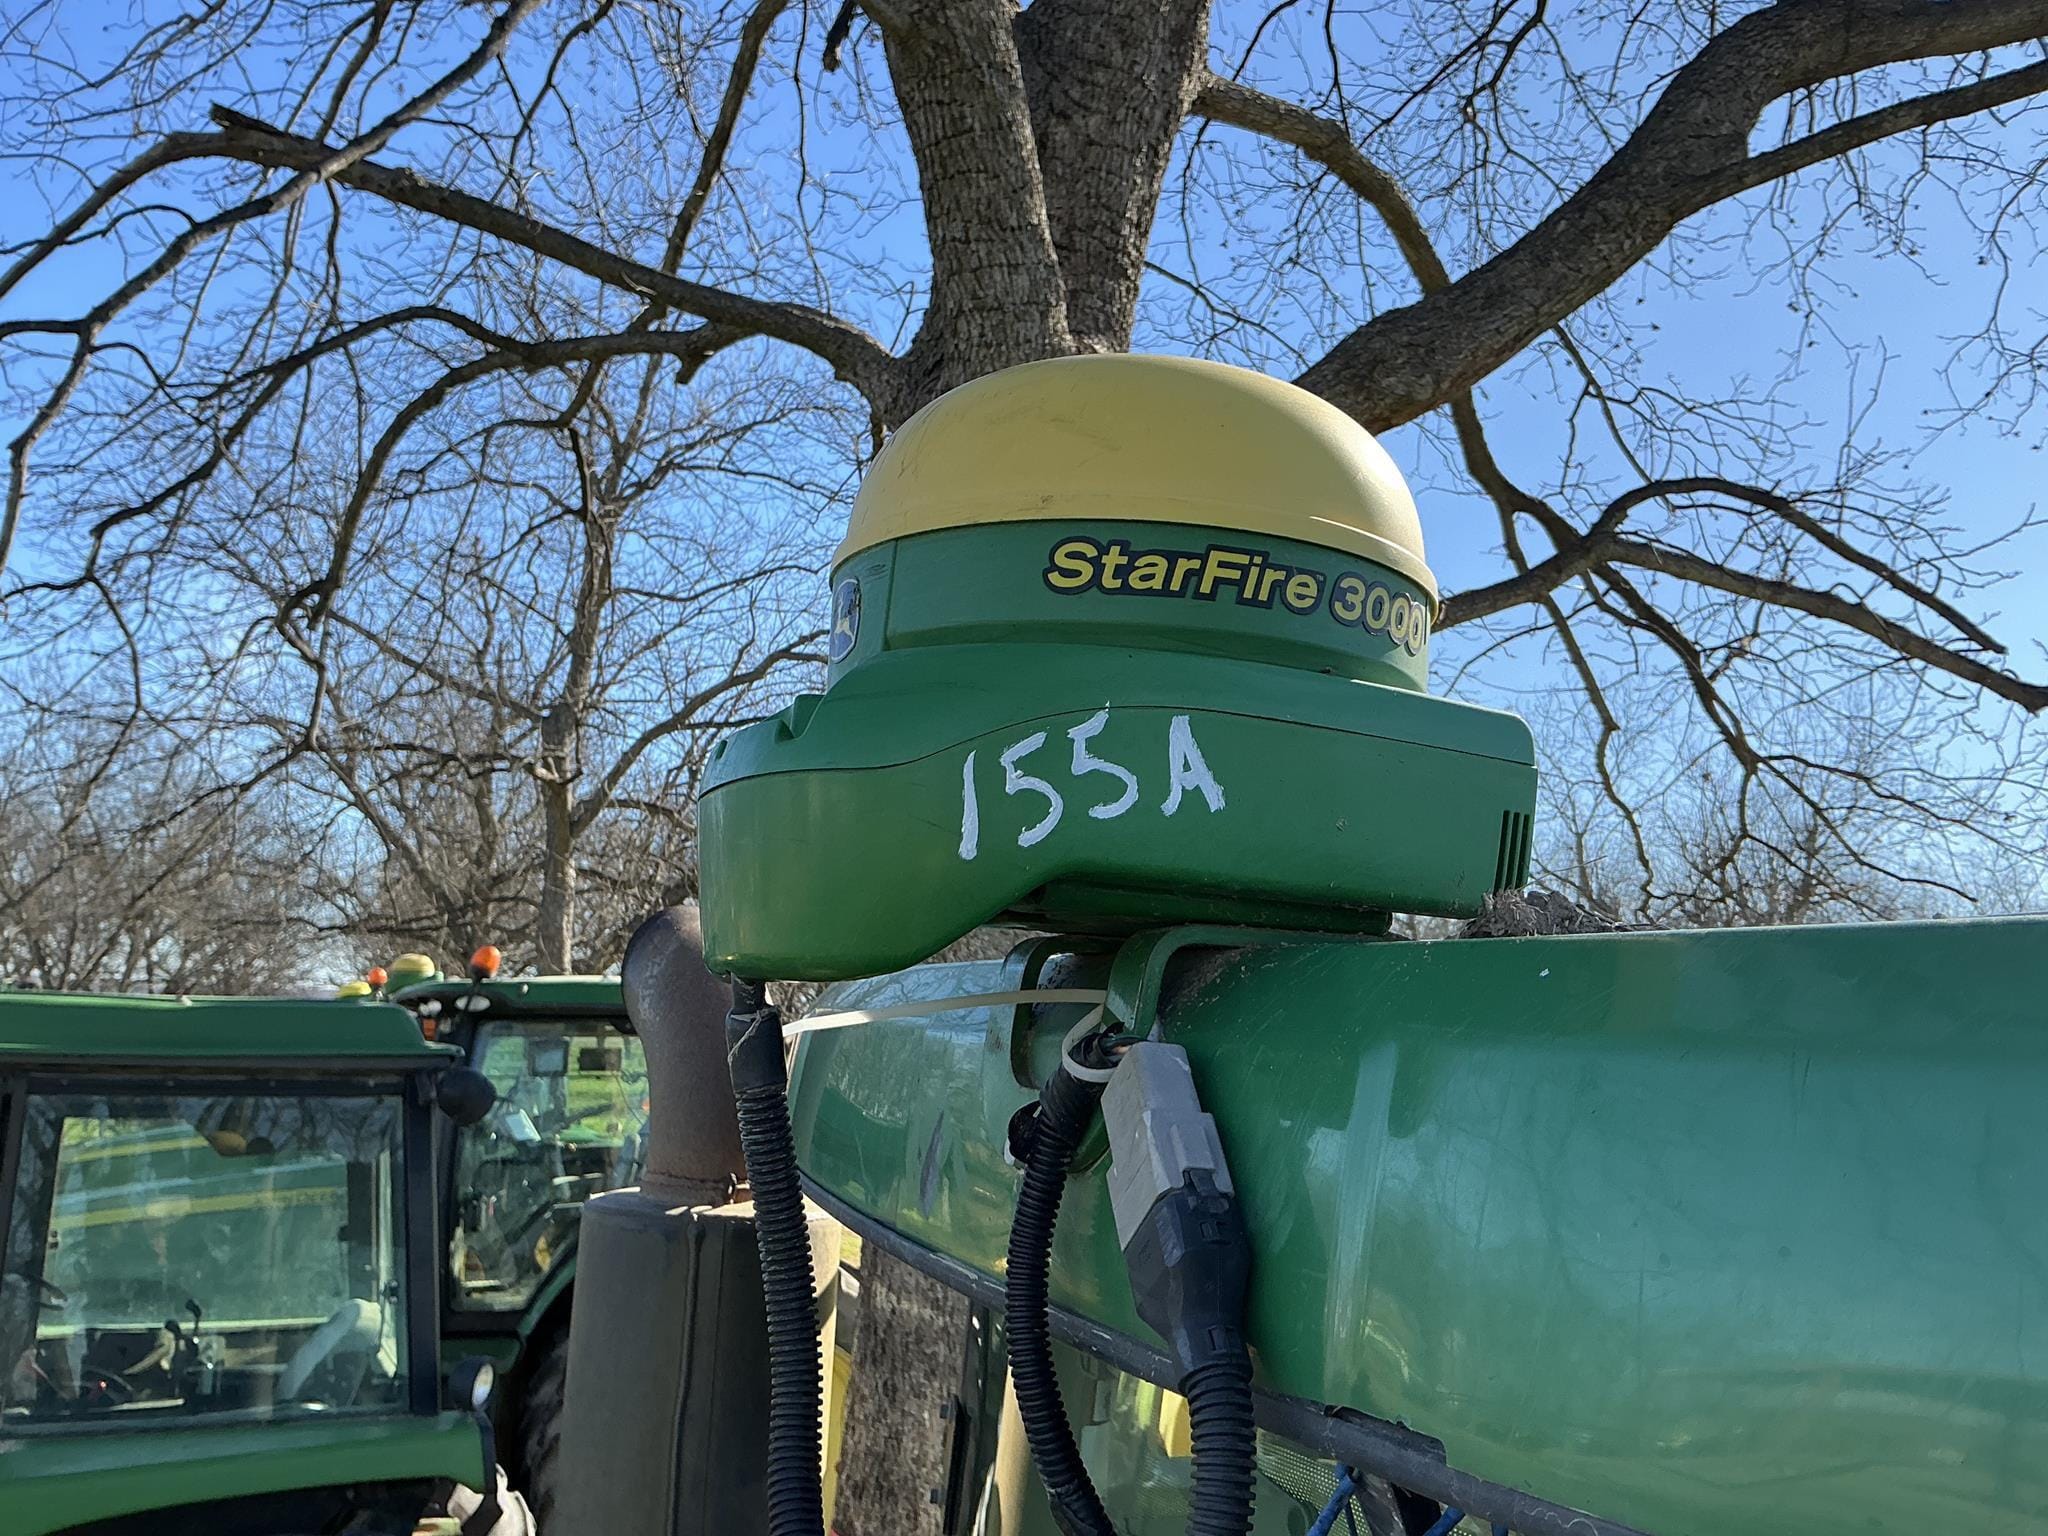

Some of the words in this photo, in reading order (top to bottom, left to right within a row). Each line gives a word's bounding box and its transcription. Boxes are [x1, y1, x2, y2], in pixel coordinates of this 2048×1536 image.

[1047, 541, 1318, 608] StarFire
[1334, 577, 1423, 650] 3000
[958, 702, 1226, 861] 155A
